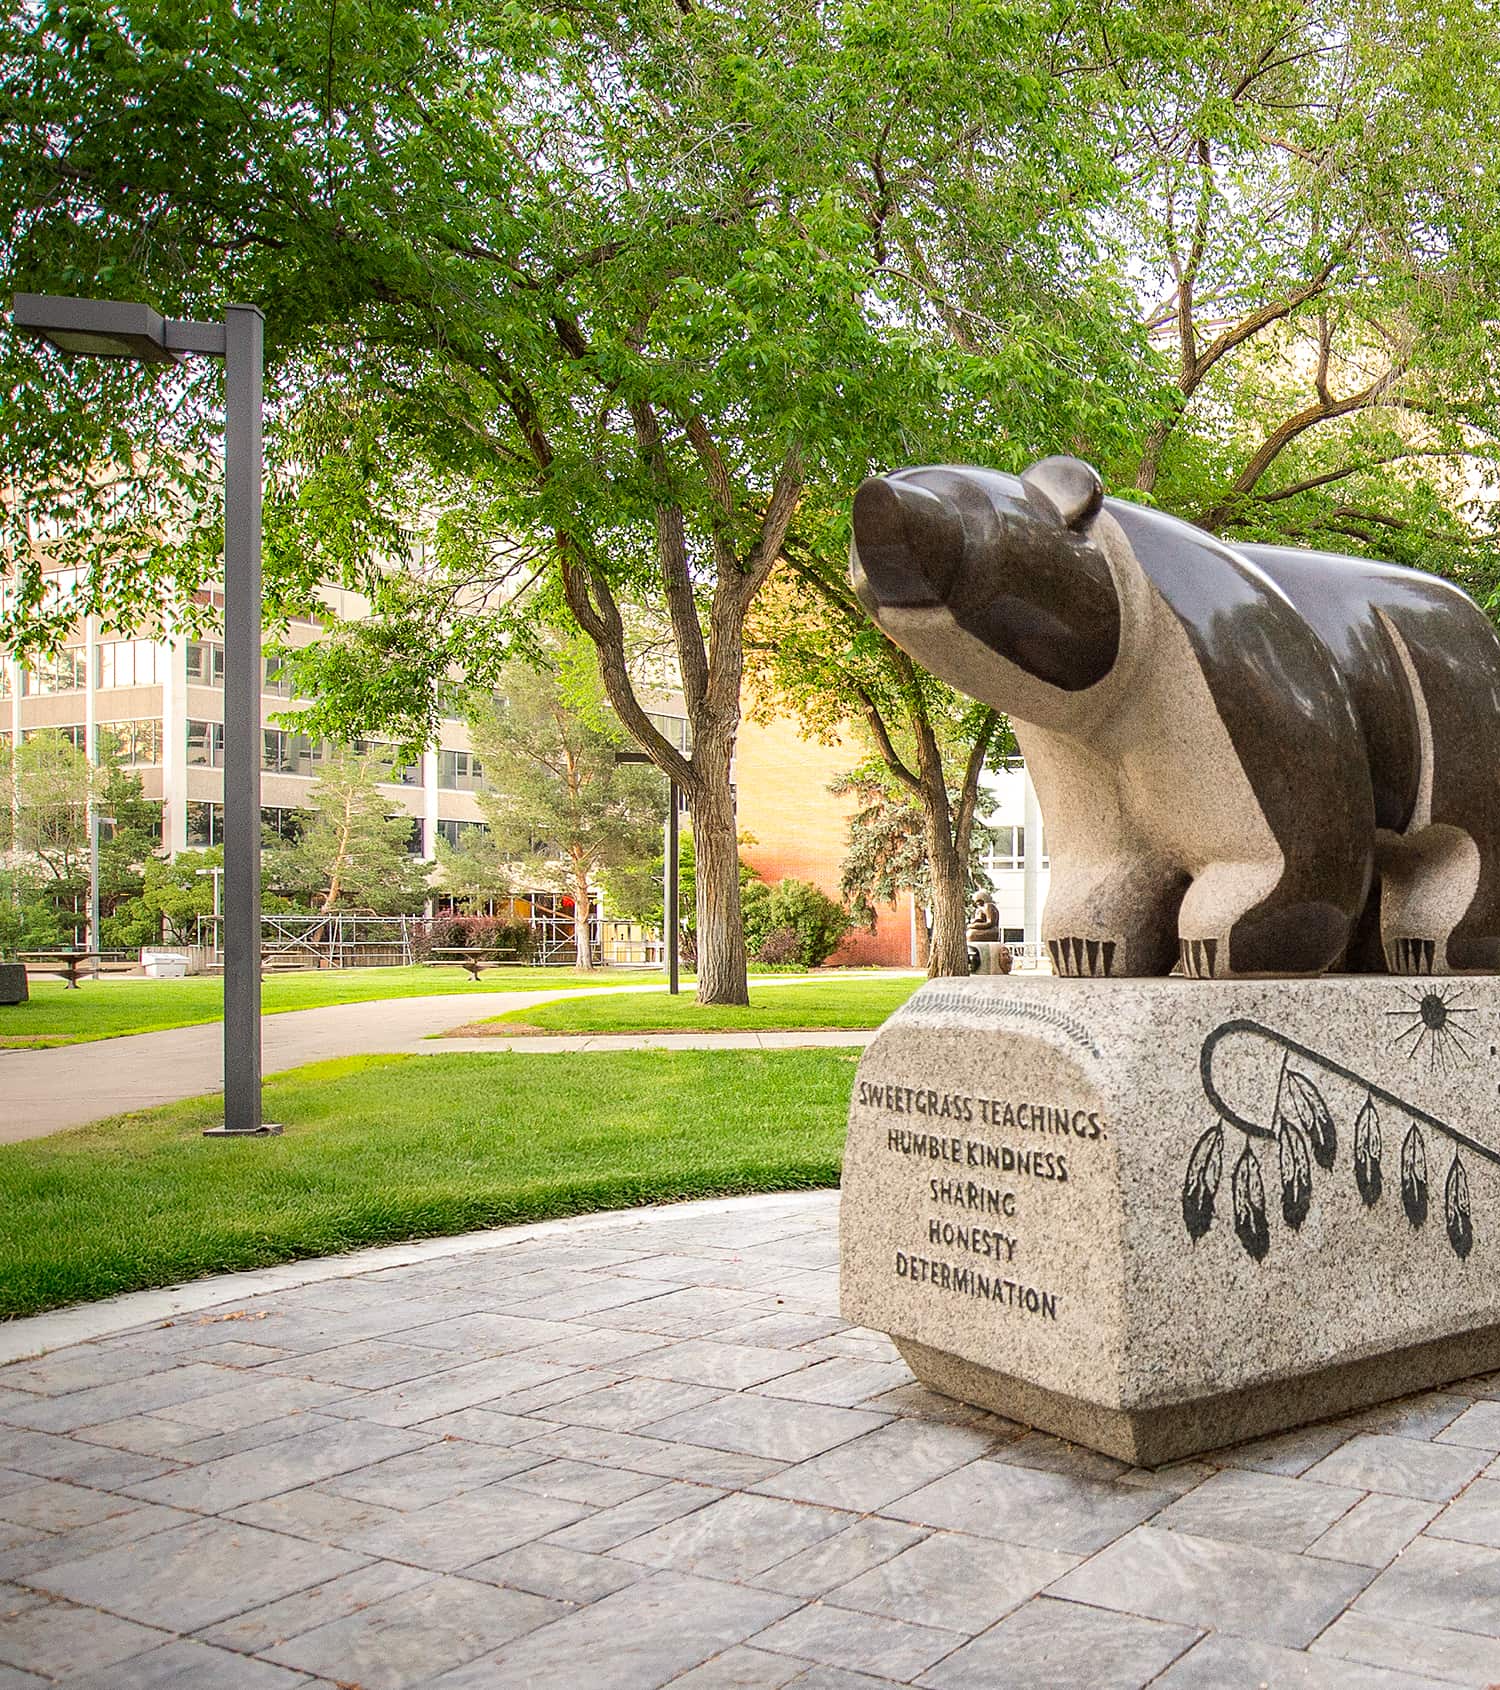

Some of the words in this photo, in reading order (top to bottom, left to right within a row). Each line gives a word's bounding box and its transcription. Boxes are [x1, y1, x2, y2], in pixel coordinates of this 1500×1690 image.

[859, 1081, 973, 1122] SWEETGRASS
[887, 1128, 961, 1163] HUMBLE
[966, 1142, 1069, 1182] KINDNESS
[930, 1178, 1016, 1217] SHARING
[928, 1218, 1017, 1262] HONESTY
[896, 1251, 1057, 1321] DETERMINATION
